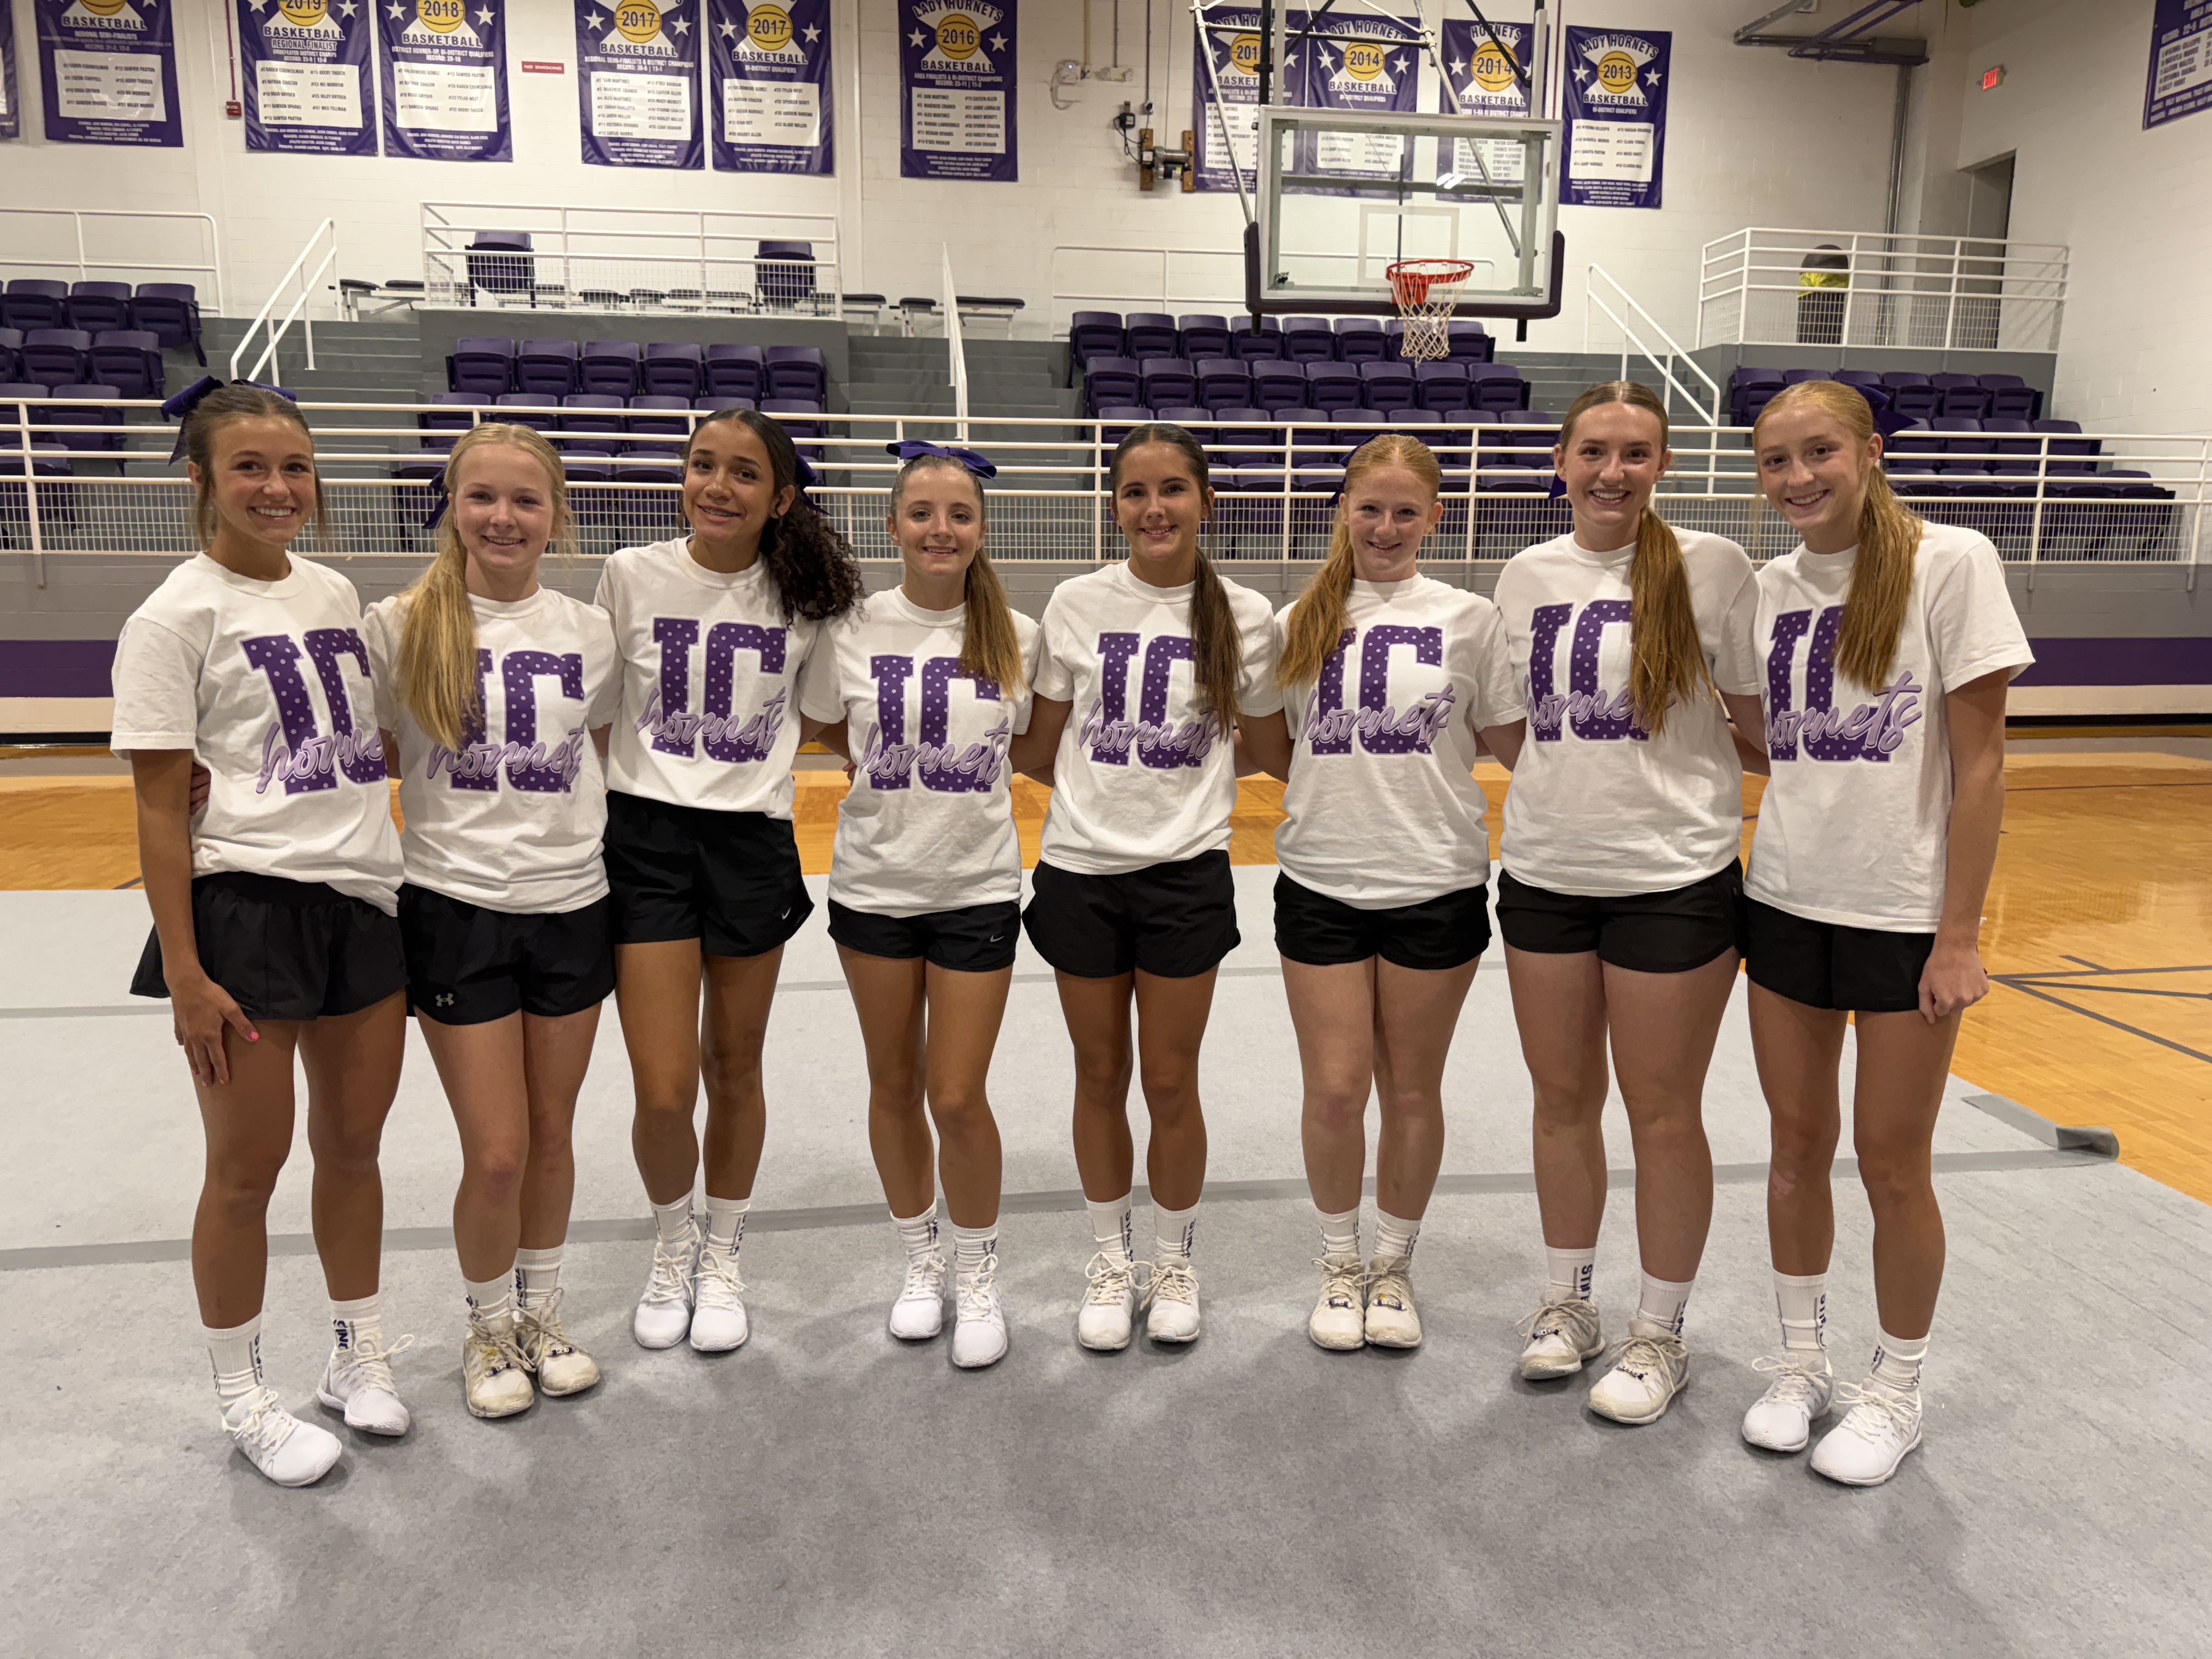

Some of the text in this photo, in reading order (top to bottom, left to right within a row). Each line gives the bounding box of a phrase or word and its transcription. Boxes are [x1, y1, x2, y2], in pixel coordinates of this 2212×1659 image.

[424, 1, 459, 17] 2018
[913, 0, 1003, 21] LADY HORNETS
[63, 16, 146, 30] BASKETBALL
[622, 11, 656, 27] 2017
[264, 26, 345, 40] BASKETBALL
[754, 19, 786, 35] 2017
[403, 33, 482, 47] BASKETBALL
[943, 29, 974, 44] 2016
[272, 40, 337, 51] REGIONAL FINALIST
[601, 43, 678, 57] BASKETBALL
[1237, 45, 1257, 60] 201
[1578, 34, 1658, 58] LADY HORNETS
[733, 51, 808, 64] BASKETBALL
[1350, 51, 1379, 66] 2014
[922, 60, 995, 72] BASKETBALL
[1477, 57, 1513, 75] 2014
[1604, 65, 1632, 79] 2013
[1329, 81, 1396, 93] BASKETBALL
[1460, 95, 1526, 106] BASKETBALL
[1584, 94, 1647, 105] BASKETBALL
[650, 617, 786, 764] IC
[1312, 624, 1443, 757] IC
[1768, 603, 1891, 763] IC
[634, 686, 786, 753] hornets
[1300, 682, 1456, 747] hornets
[1762, 670, 1922, 754] hornets
[870, 654, 1001, 793] IC
[860, 715, 1010, 785] hornets
